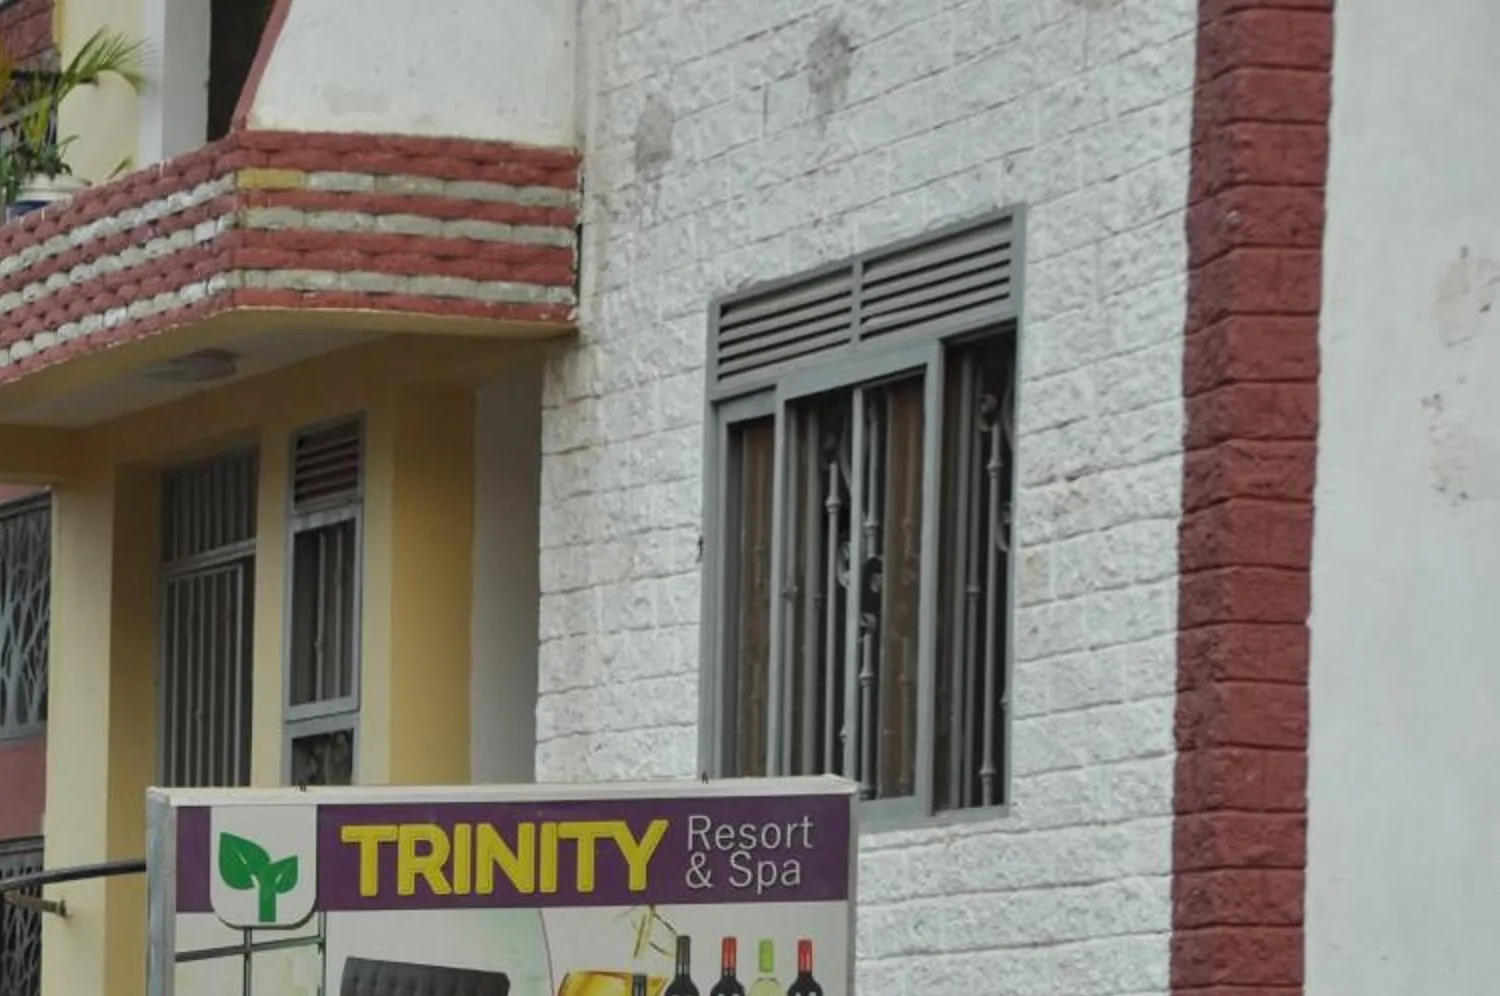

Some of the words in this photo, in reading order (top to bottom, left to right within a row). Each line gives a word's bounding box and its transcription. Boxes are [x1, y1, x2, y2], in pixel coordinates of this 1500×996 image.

[687, 814, 814, 850] Resort
[341, 820, 669, 896] TRINITY
[685, 851, 714, 889] &
[728, 850, 801, 895] Spa
